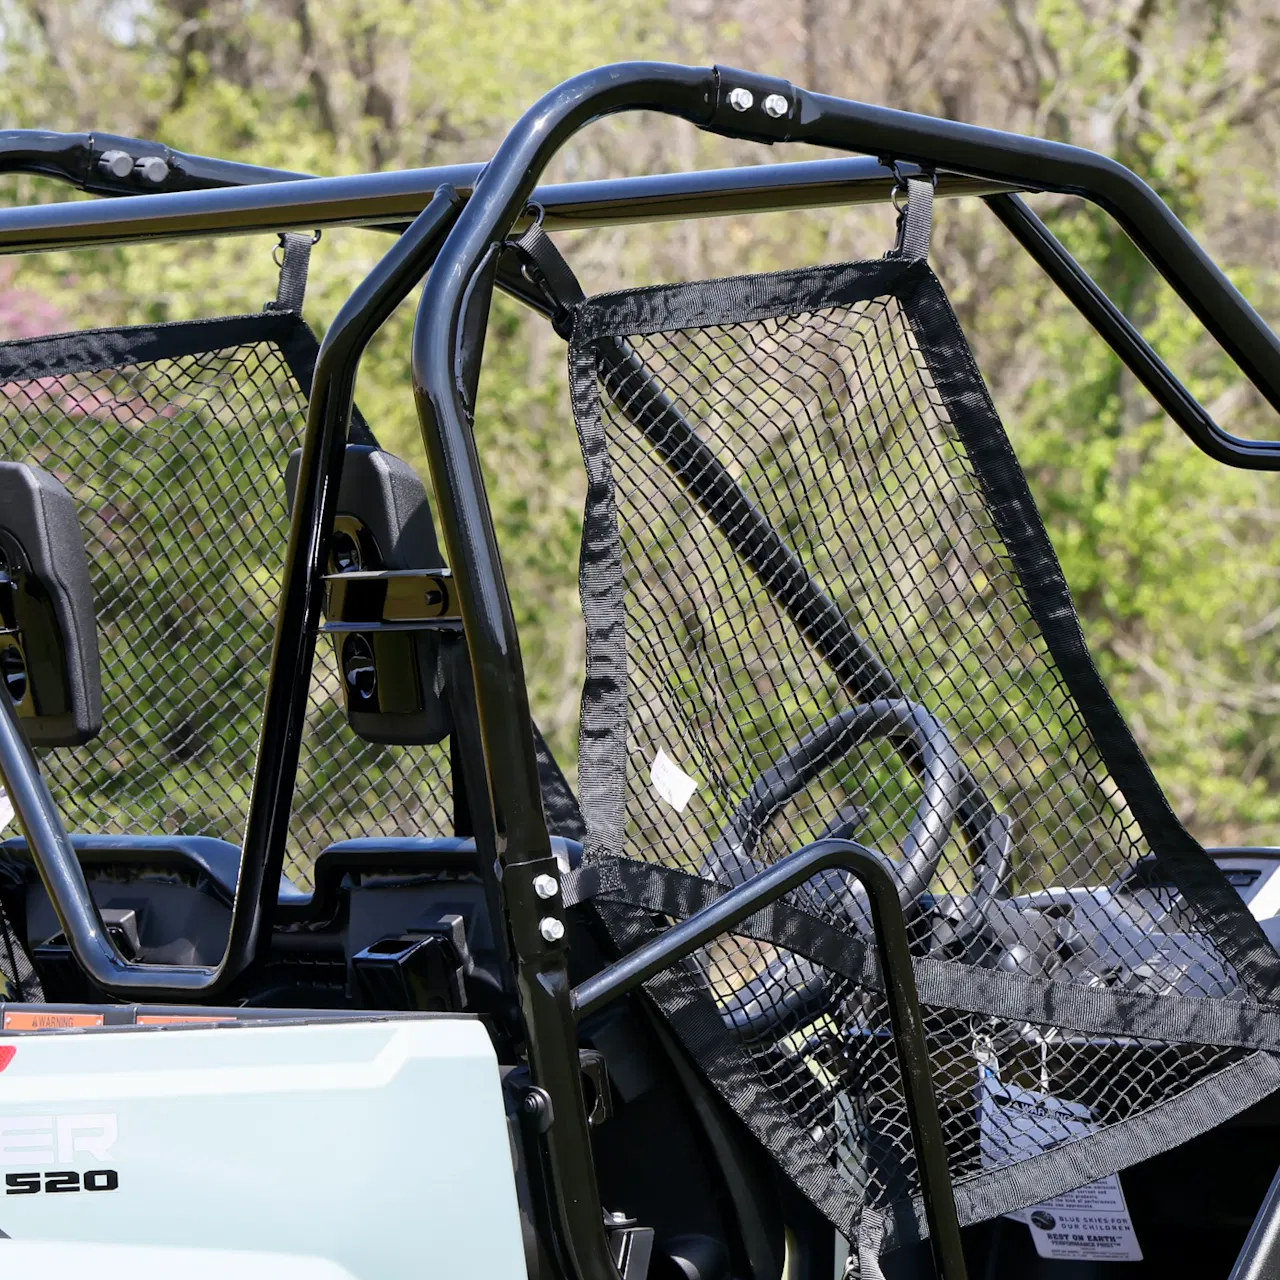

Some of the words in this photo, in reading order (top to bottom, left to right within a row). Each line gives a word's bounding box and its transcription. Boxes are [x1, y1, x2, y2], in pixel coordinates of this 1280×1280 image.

[40, 1015, 74, 1028] WARNING
[1021, 1101, 1073, 1121] WARNG
[6, 1169, 119, 1195] 520
